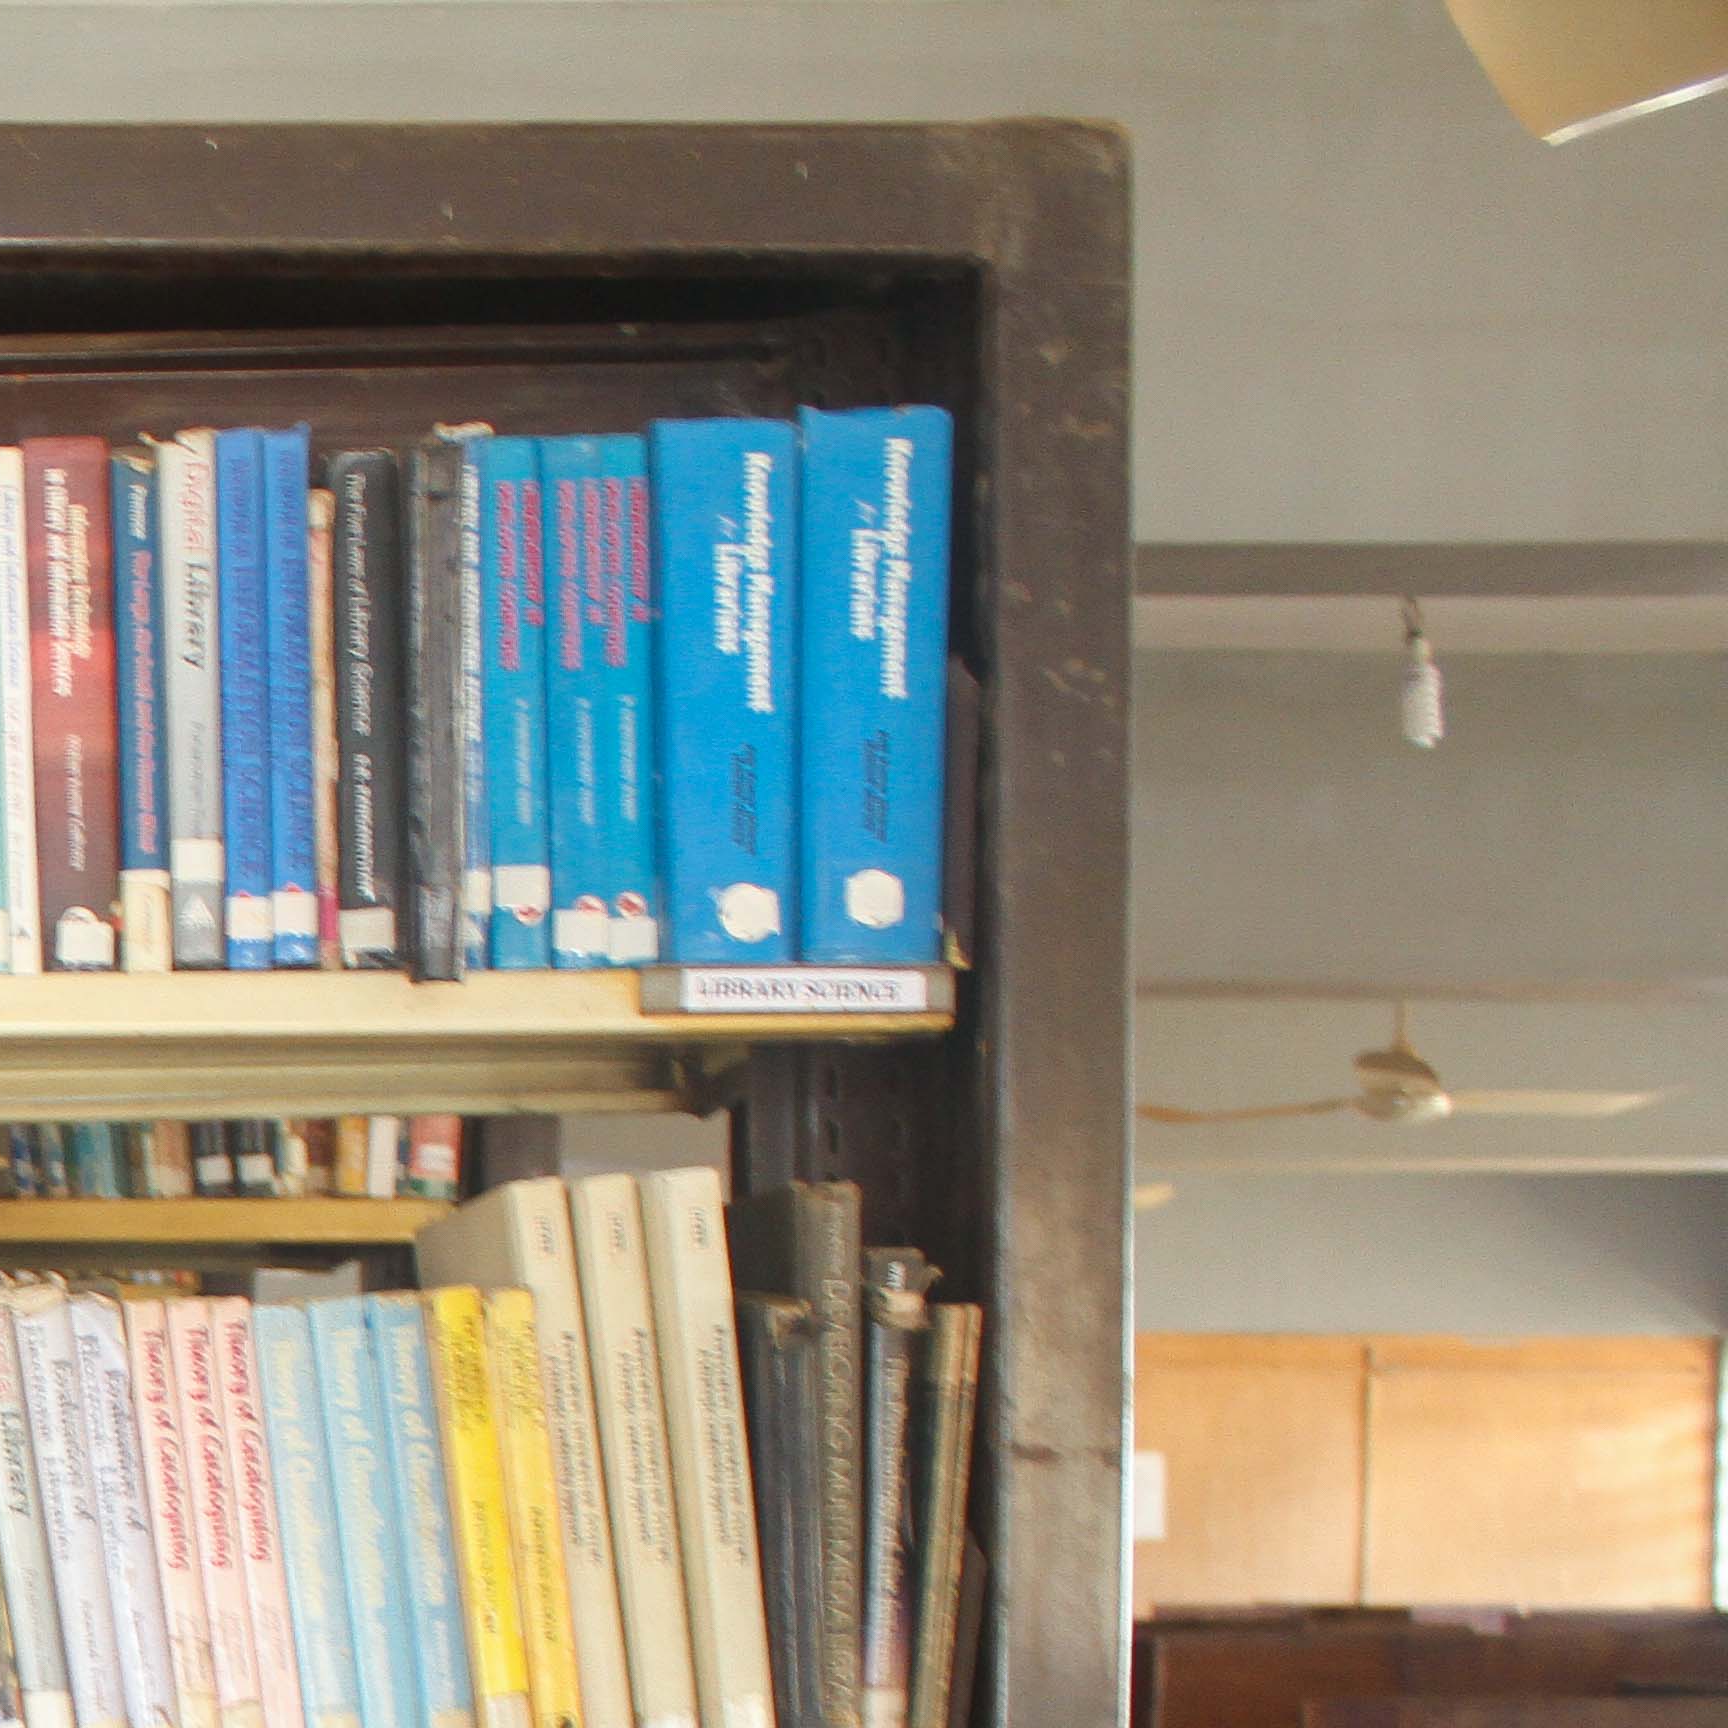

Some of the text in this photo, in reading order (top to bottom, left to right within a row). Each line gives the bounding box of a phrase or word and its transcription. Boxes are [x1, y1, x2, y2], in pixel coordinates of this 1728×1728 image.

[740, 452, 772, 573] Knowledge
[878, 438, 912, 697] Knowledge Management
[174, 559, 214, 669] Library
[712, 543, 742, 654] Librarians
[742, 575, 773, 712] Management
[699, 977, 899, 1001] LIBRARY SCIENCE
